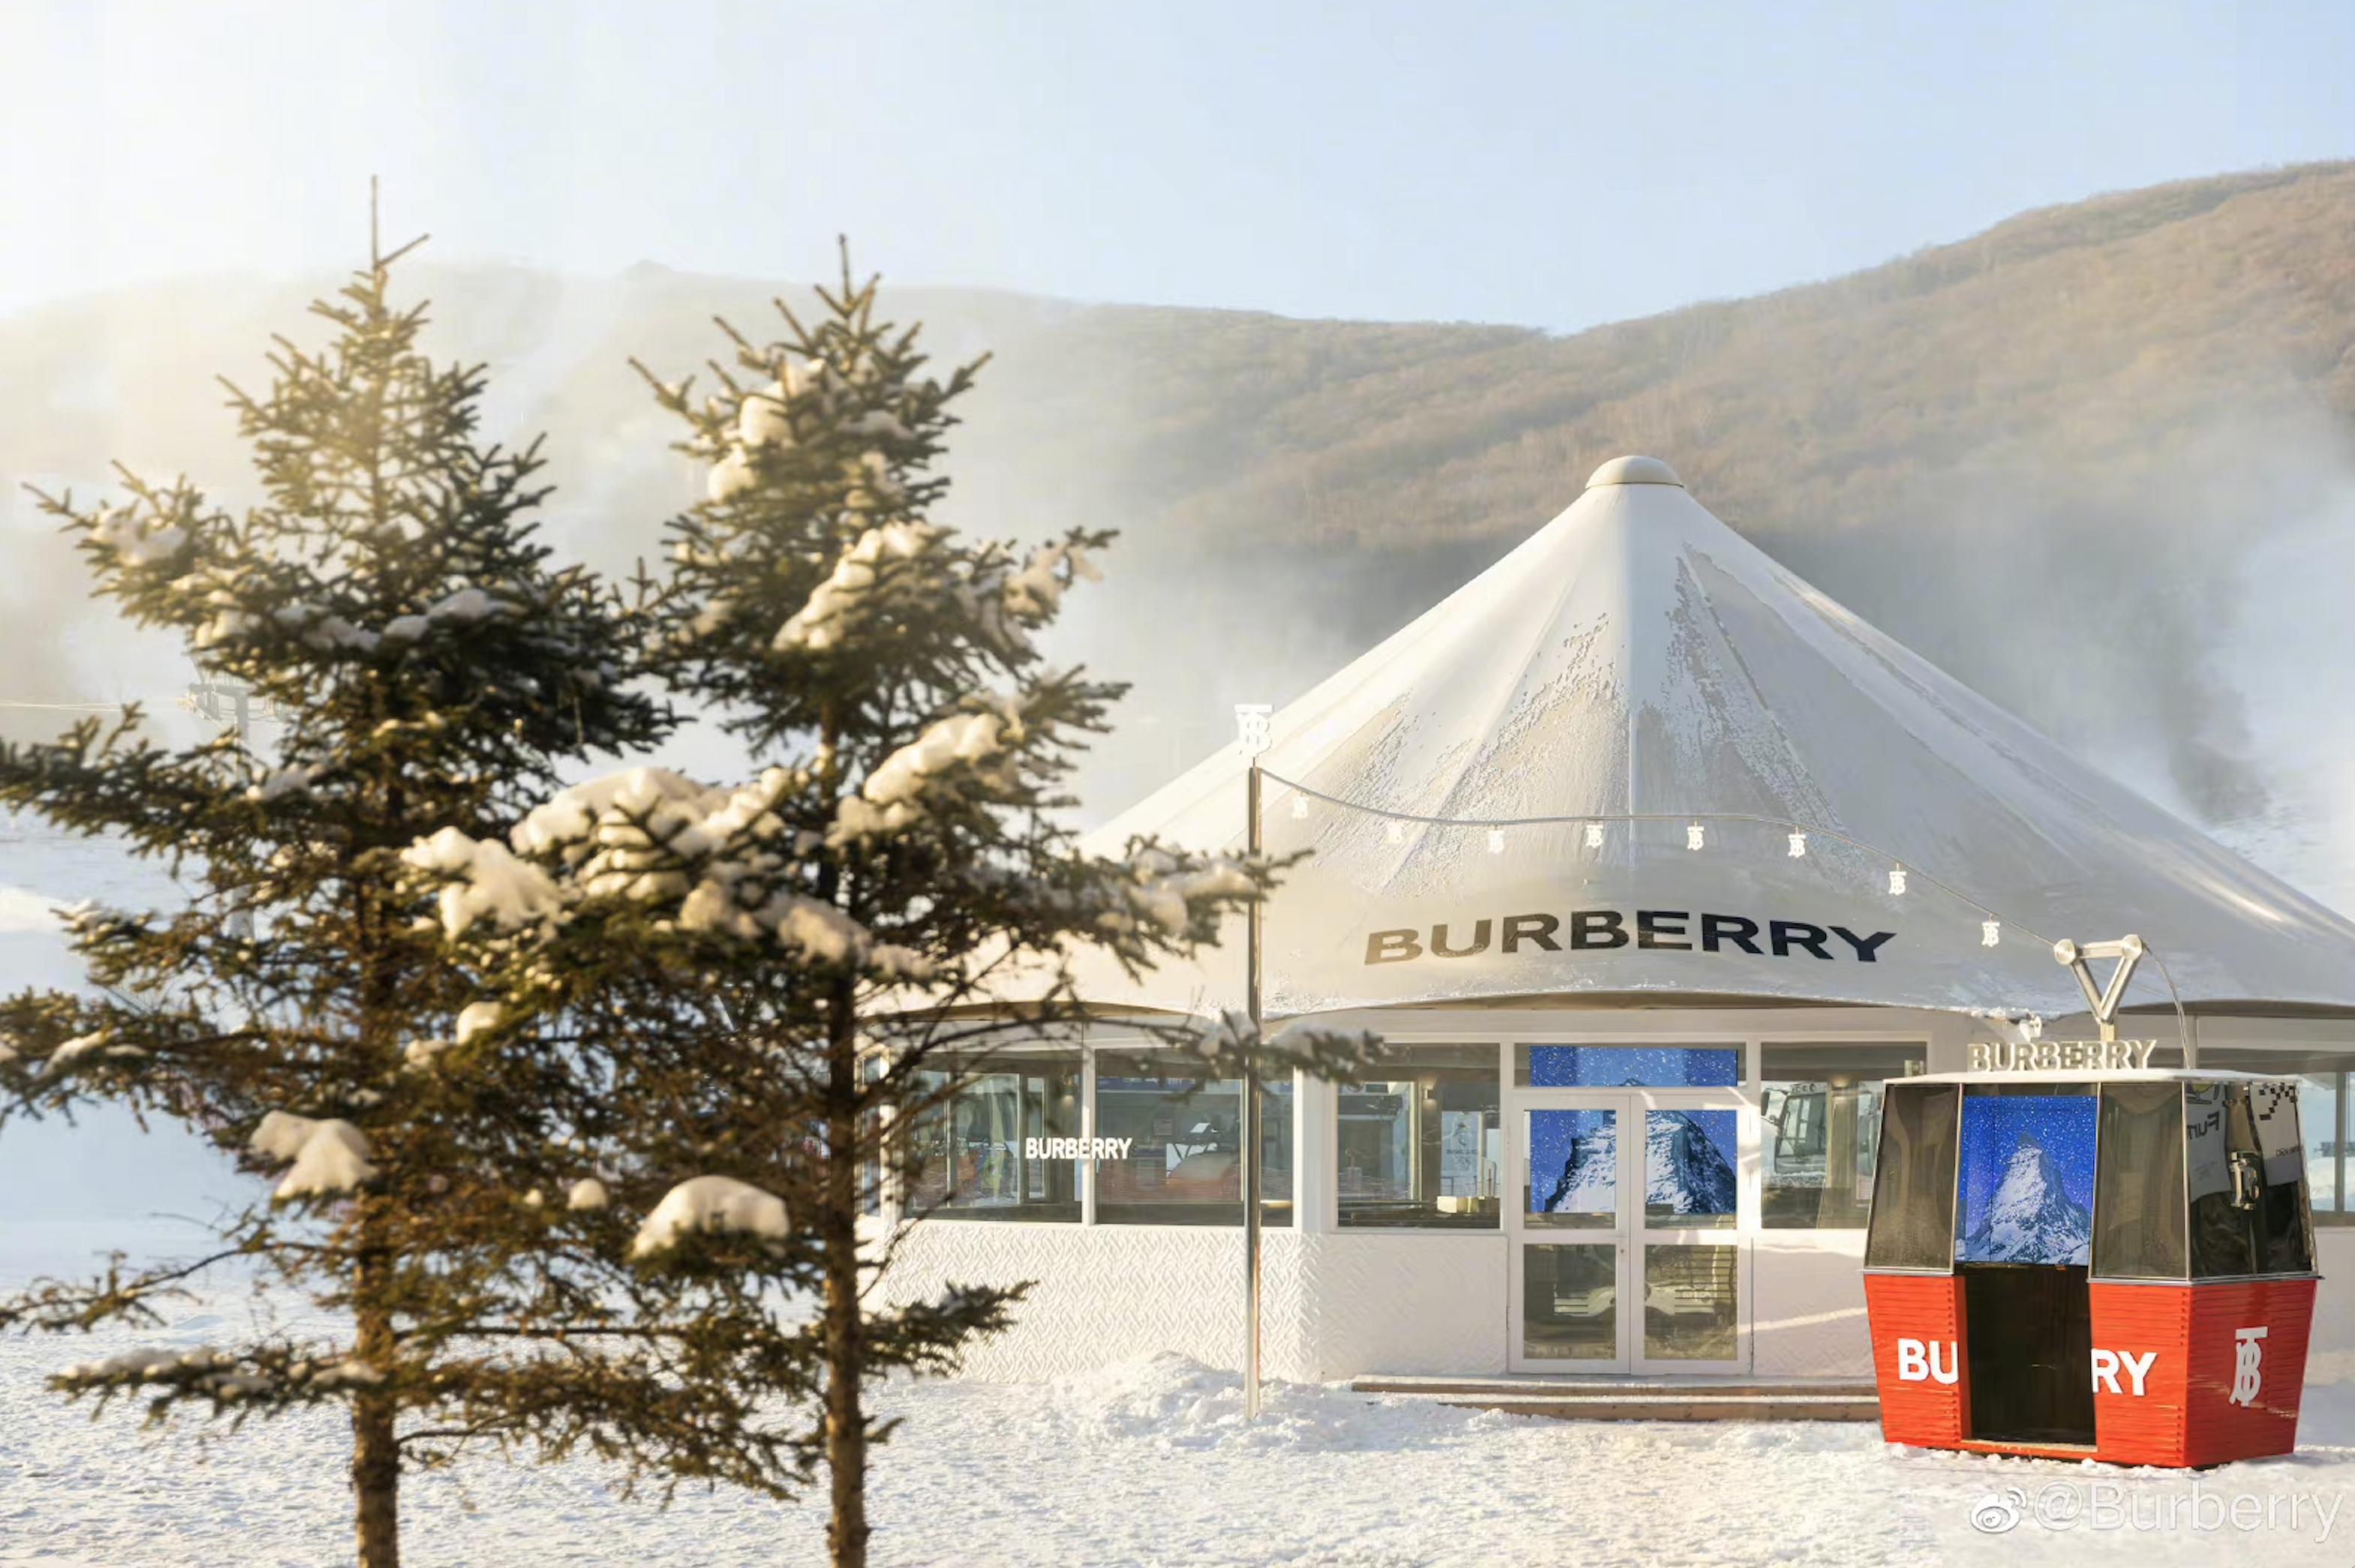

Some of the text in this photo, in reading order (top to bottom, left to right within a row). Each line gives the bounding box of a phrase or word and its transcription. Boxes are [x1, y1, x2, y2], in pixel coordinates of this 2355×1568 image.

[1365, 910, 1896, 966] BURBERRY
[1967, 1040, 2157, 1071] BURBERRY
[1025, 1137, 1132, 1159] BURBERRY
